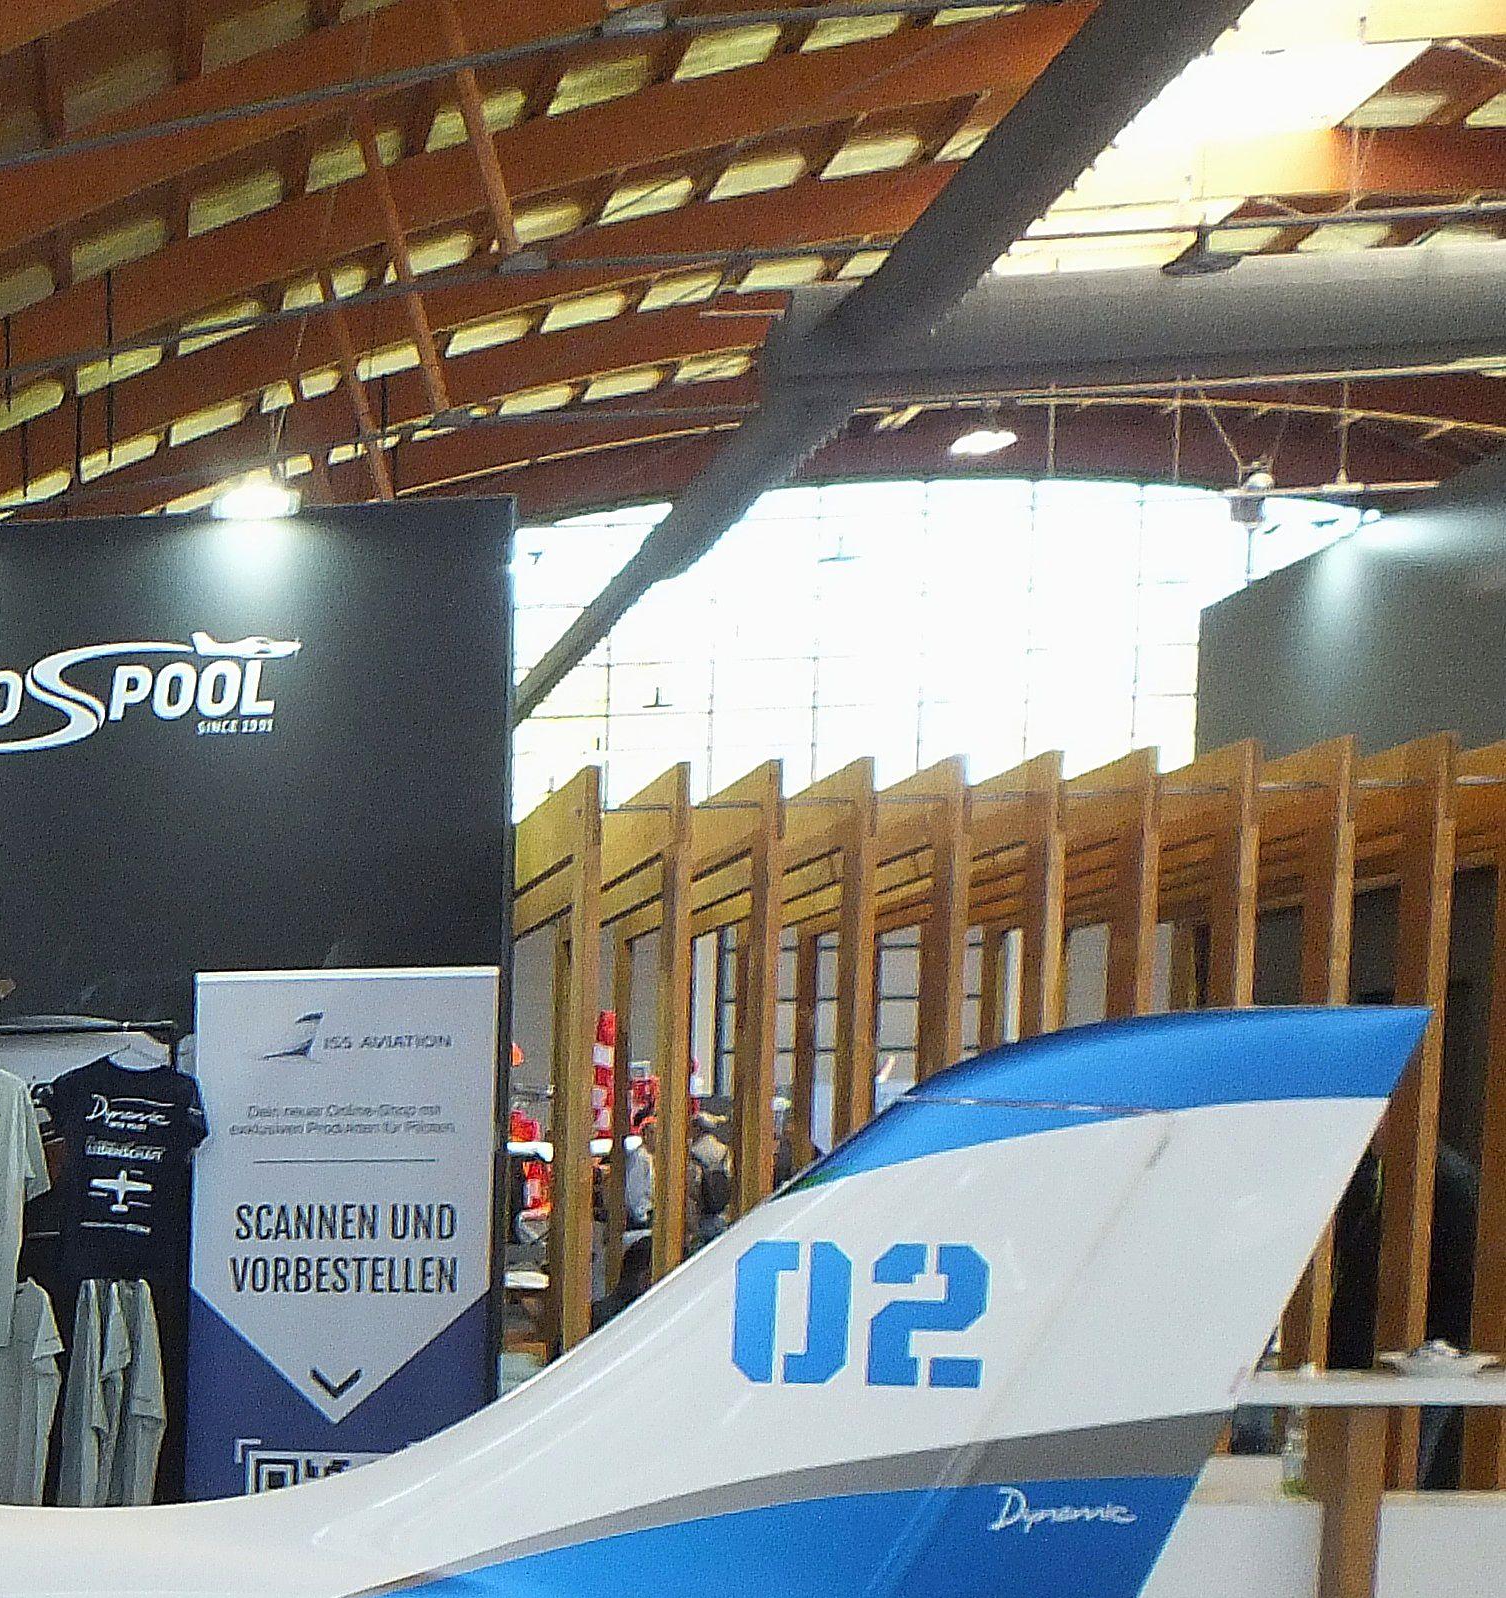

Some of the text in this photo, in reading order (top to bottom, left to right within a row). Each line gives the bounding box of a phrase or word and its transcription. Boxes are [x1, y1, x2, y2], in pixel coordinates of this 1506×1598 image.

[197, 719, 238, 735] SINCE
[359, 1034, 453, 1050] AVIATION
[86, 1093, 172, 1126] Dynamic
[235, 1202, 457, 1243] SCANNEN UND
[229, 1255, 458, 1295] VORBESTELLEN
[730, 1240, 991, 1390] 02
[988, 1485, 1138, 1532] Dynamic
